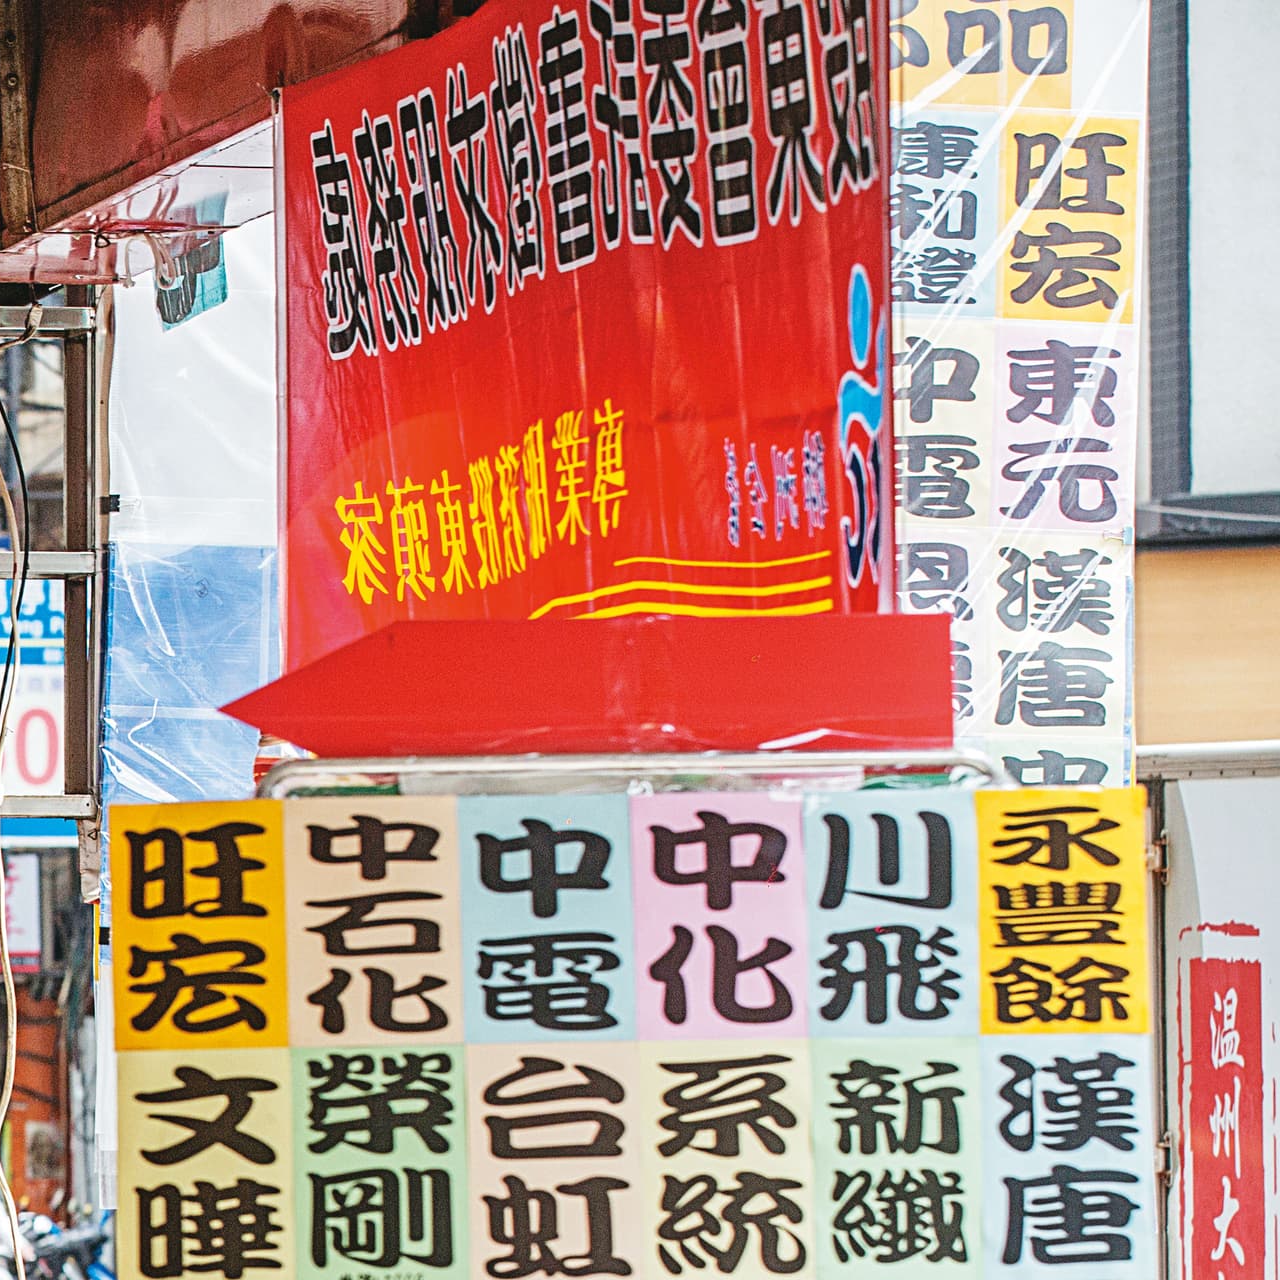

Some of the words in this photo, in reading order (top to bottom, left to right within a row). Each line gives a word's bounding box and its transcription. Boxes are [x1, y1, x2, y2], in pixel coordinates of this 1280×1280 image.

[1009, 131, 1128, 310] 旺宏
[998, 338, 1122, 523] 東元
[994, 546, 1115, 728] 漢唐
[123, 821, 269, 1034] 旺宏
[305, 814, 449, 1035] 中石化
[475, 818, 621, 1031] 中電
[649, 810, 793, 1025] 中化
[818, 811, 962, 1025] 川飛
[989, 806, 1130, 1024] 永豐餘
[134, 1065, 284, 1280] 文曄
[307, 1052, 454, 1269] 榮剛
[482, 1056, 633, 1280] 台虹
[657, 1054, 807, 1275] 系統
[829, 1059, 968, 1264] 新纖
[999, 1052, 1141, 1265] 漢唐
